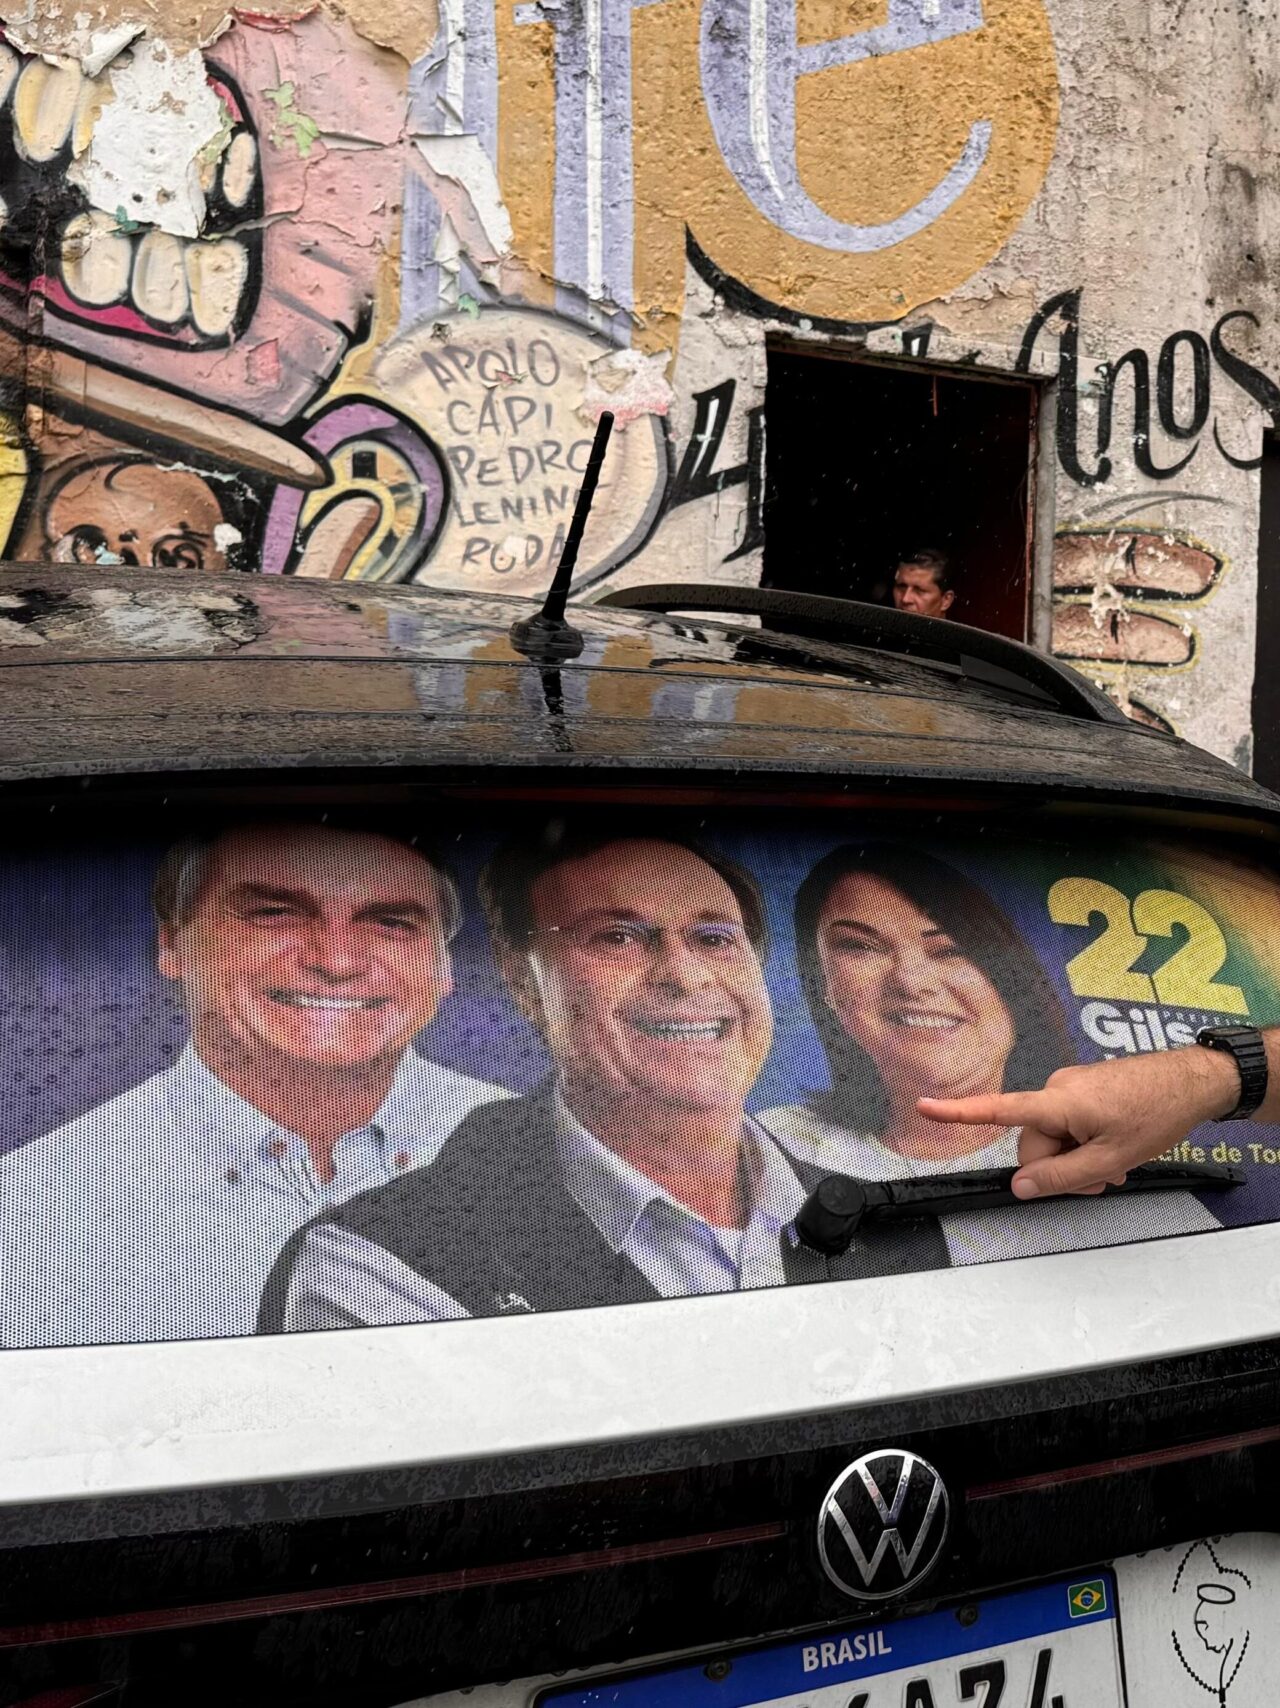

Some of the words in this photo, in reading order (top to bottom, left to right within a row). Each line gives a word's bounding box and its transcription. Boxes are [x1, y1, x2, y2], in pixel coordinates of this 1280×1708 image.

[420, 337, 560, 393] APOLO
[446, 439, 597, 488] PEDRO
[453, 484, 585, 529] LENIN
[1047, 877, 1249, 1014] 22
[1079, 1000, 1212, 1053] Gils
[1150, 1140, 1206, 1164] cife
[1211, 1141, 1243, 1163] de
[801, 1630, 892, 1673] BRASIL
